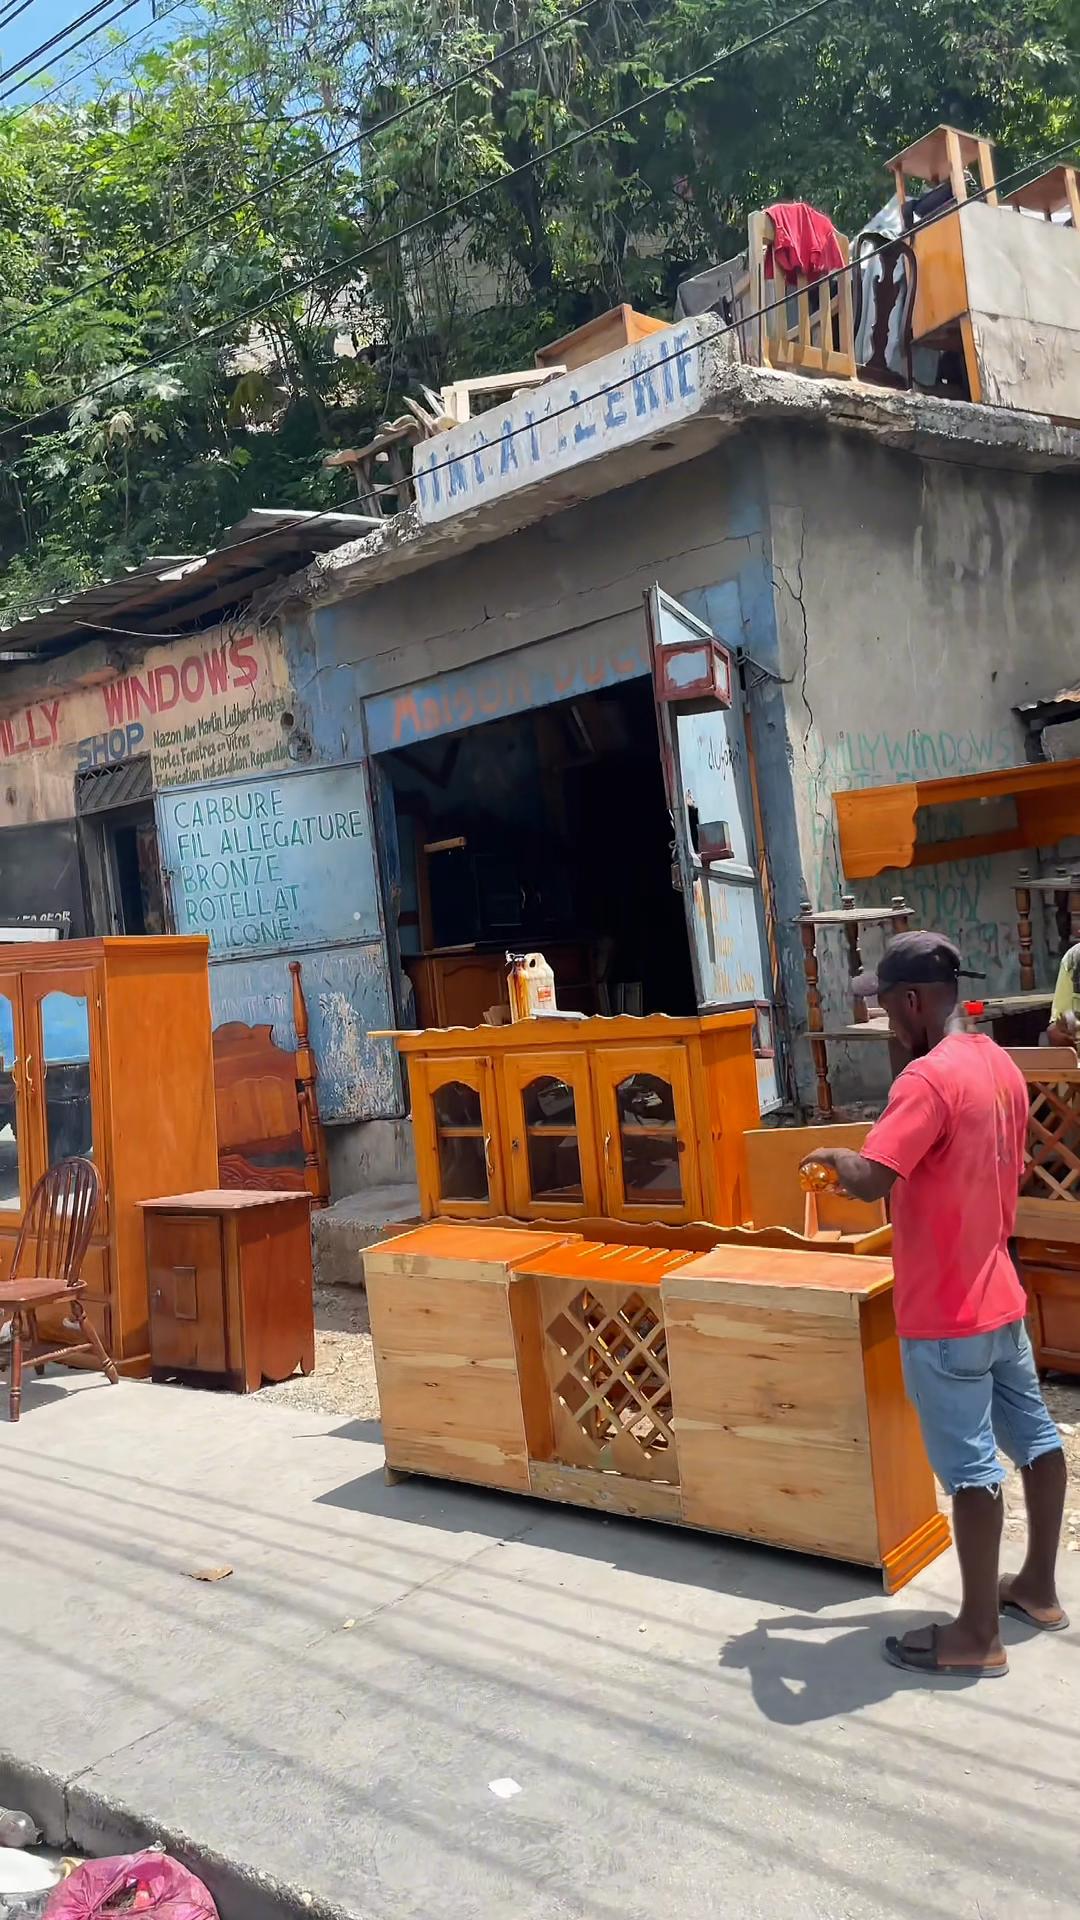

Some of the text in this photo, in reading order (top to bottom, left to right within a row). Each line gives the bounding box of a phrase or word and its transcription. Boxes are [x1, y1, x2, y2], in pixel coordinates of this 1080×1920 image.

[103, 636, 258, 727] WINDOWS
[78, 722, 144, 770] SHOP
[153, 729, 181, 748] Nazon
[198, 712, 222, 736] Martin
[174, 789, 284, 829] CARBURE
[178, 810, 363, 861] FIL ALLEGATURE
[181, 854, 283, 894] BRONZE
[185, 884, 299, 925] ROTELLAT
